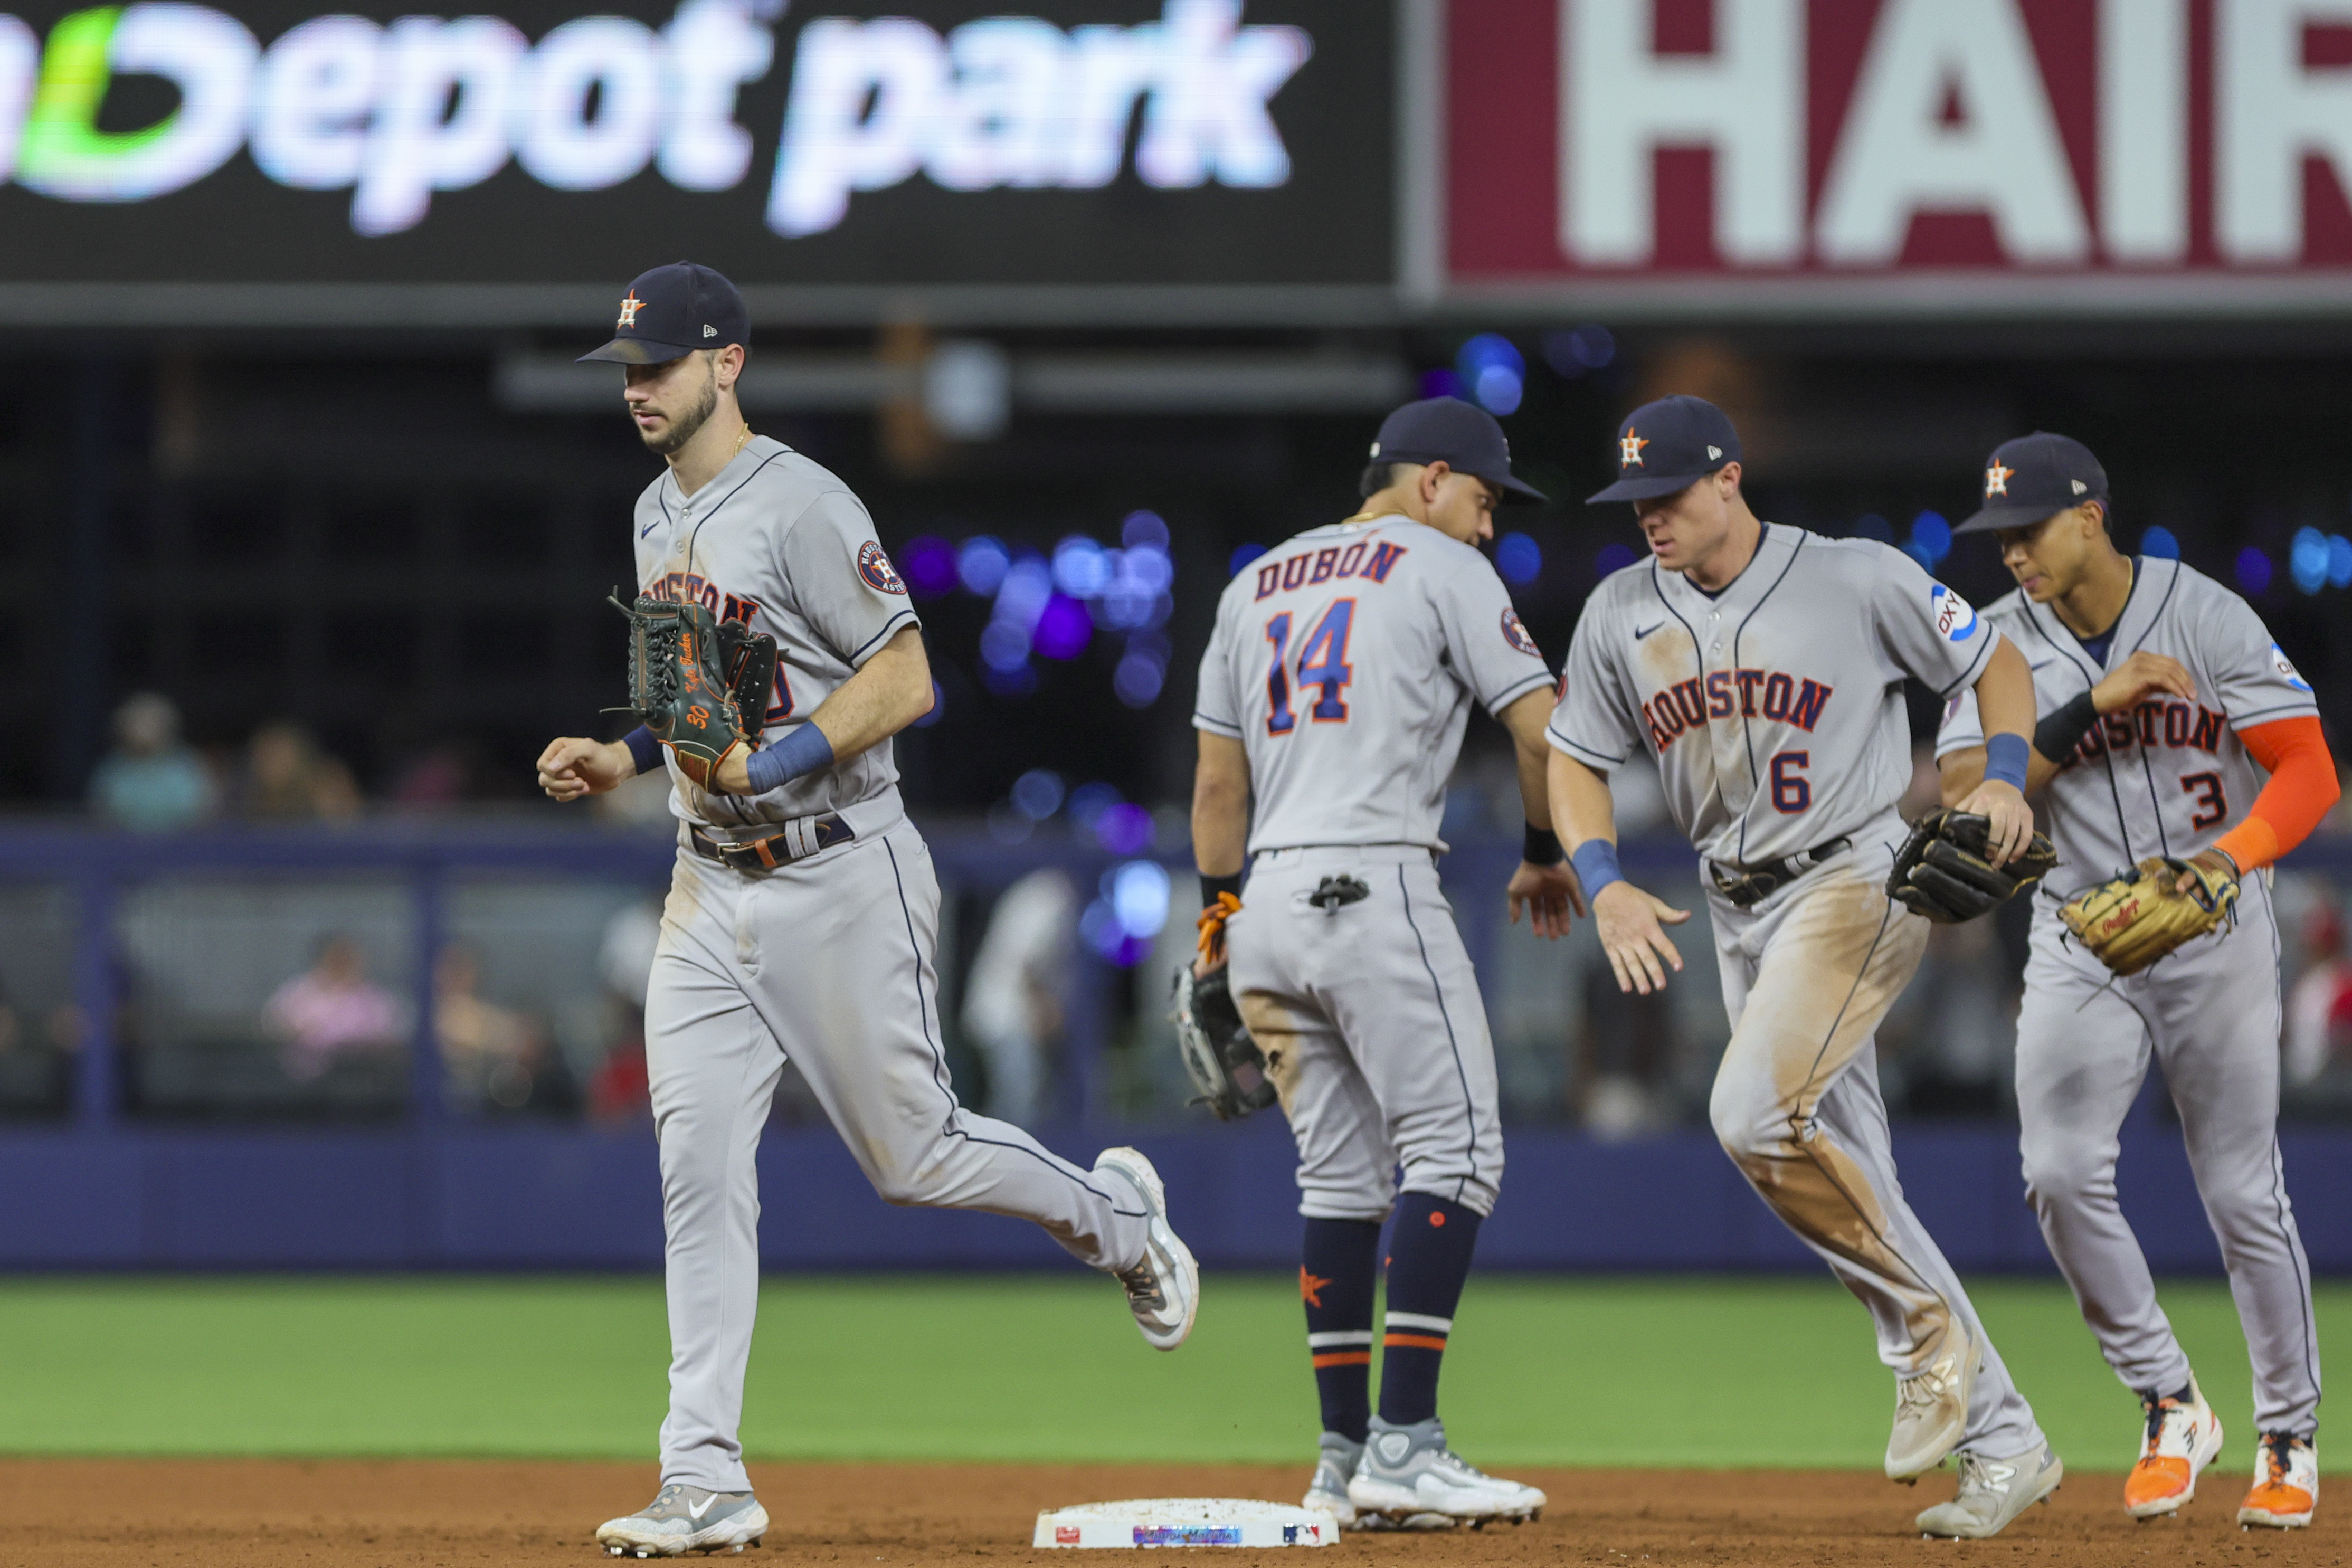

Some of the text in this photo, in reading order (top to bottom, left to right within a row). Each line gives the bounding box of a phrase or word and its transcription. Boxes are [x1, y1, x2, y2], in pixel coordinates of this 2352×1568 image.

[765, 0, 1315, 237] park
[1939, 591, 1960, 634] OXY
[1266, 597, 1357, 737] 14
[686, 705, 710, 730] 30
[1642, 668, 1833, 754] HOUSTON
[1770, 750, 1812, 814] 6
[2180, 769, 2228, 832] 3
